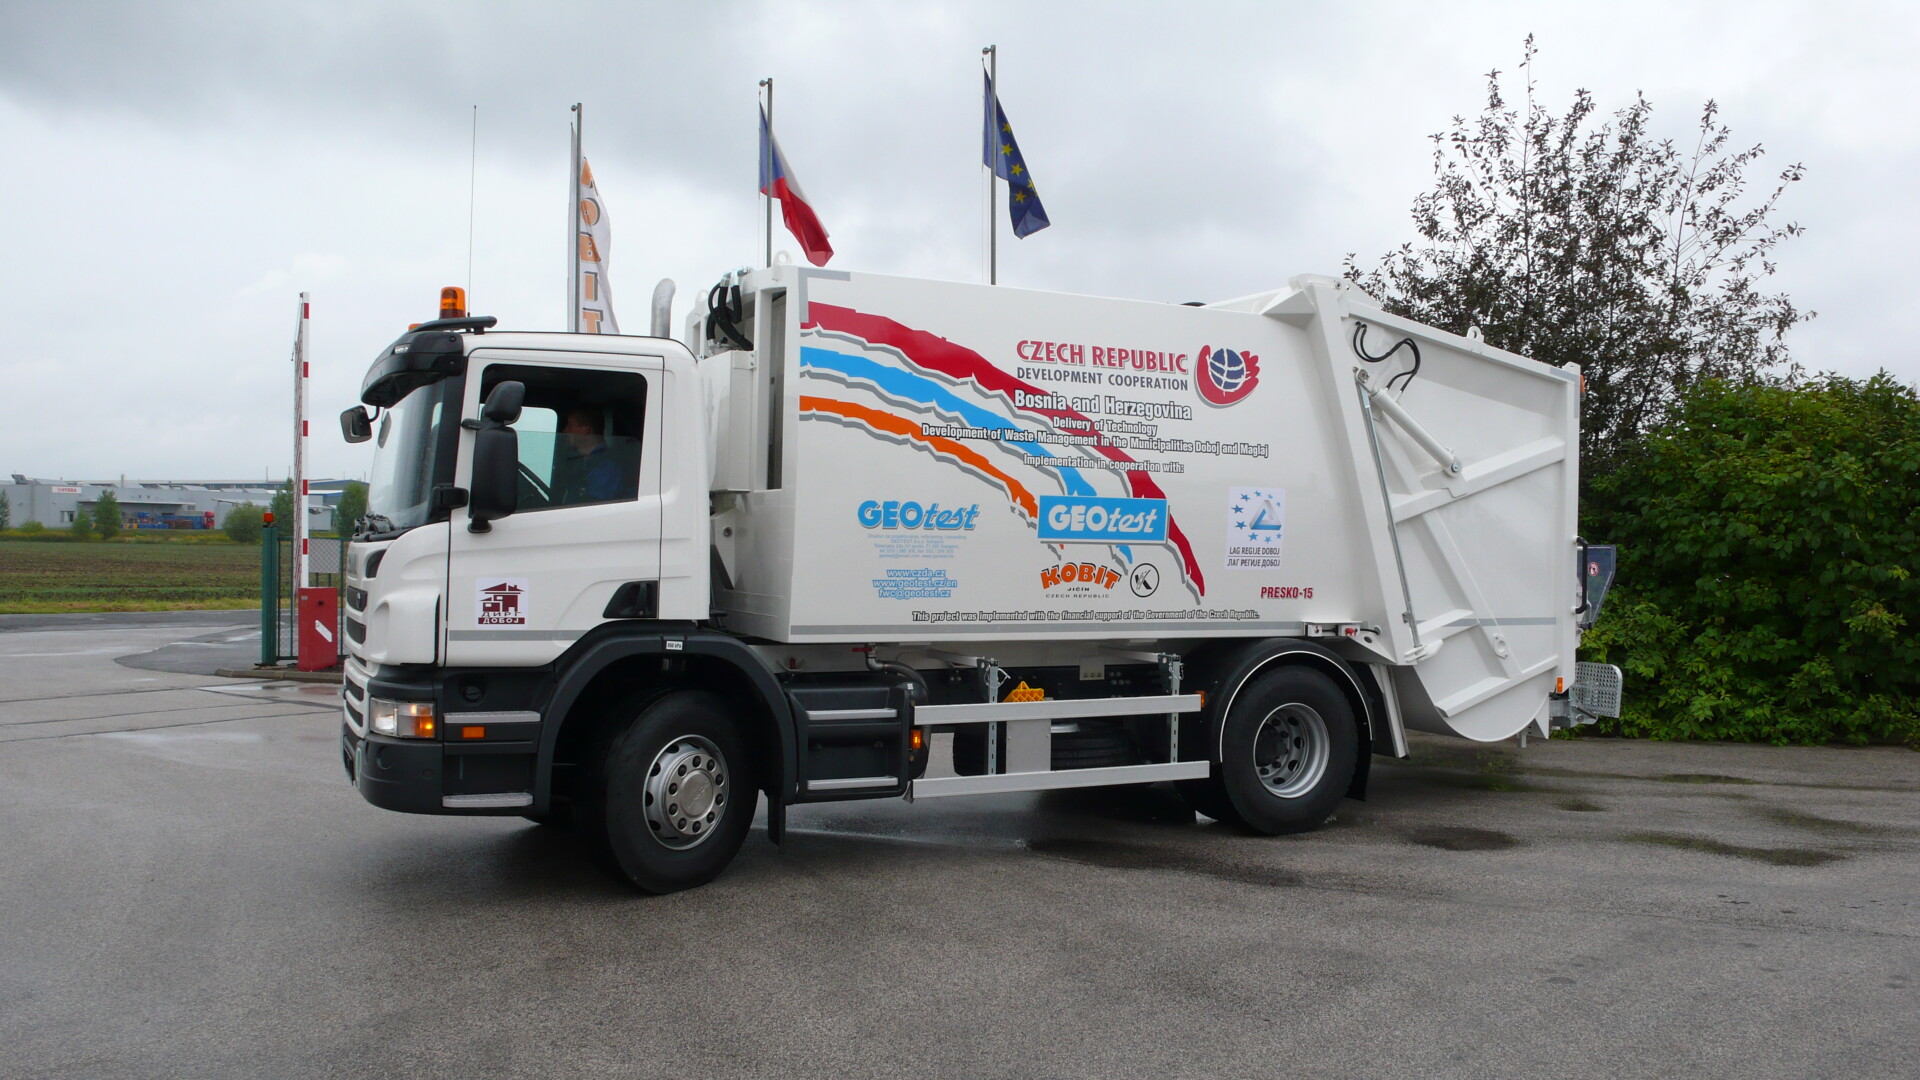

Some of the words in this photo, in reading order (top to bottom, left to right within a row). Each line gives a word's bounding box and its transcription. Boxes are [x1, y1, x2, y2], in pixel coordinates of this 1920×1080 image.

[1016, 340, 1085, 366] CZECH
[1092, 345, 1188, 375] REPUBLIC
[1017, 366, 1103, 385] DEVELOPMENT
[1108, 373, 1188, 391] COOPERATION
[1014, 389, 1067, 411] Bosnia
[1072, 395, 1100, 414] and
[1105, 396, 1192, 420] Herzegovina
[1053, 416, 1091, 432] Delivery
[1094, 419, 1104, 431] of
[1106, 420, 1157, 437] Technology
[922, 423, 988, 441] Development
[990, 428, 1001, 440] of
[1004, 429, 1034, 442] Waste
[1037, 431, 1097, 447] Management
[1100, 435, 1111, 447] in
[1112, 436, 1127, 448] the
[1130, 436, 1193, 453] Municipalities
[1195, 441, 1220, 455] Doboj
[1222, 443, 1238, 454] and
[1239, 444, 1269, 458] Maglaj
[1023, 453, 1094, 469] Implementation
[1097, 458, 1106, 469] in
[1109, 459, 1160, 473] cooperation
[1162, 462, 1185, 473] with:
[857, 500, 980, 530] GEOtest
[1048, 504, 1157, 533] GEOtest
[1229, 547, 1240, 555] LAG
[1241, 547, 1261, 555] REGIJE
[1262, 547, 1280, 556] DOBOJ
[1227, 558, 1239, 567] ЛАГ
[886, 568, 946, 578] www.czda.cz
[1040, 562, 1122, 590] KOBIT
[872, 578, 957, 589] www.geotest.cz/en
[1260, 586, 1314, 599] PRESKO-15
[878, 588, 951, 600] fwc@geotest.cz
[912, 611, 929, 621] This
[961, 611, 977, 621] was
[978, 611, 1028, 622] implemented
[1029, 611, 1046, 621] with
[1047, 611, 1060, 621] the
[1061, 610, 1094, 621] financial
[1095, 610, 1122, 622] support
[1123, 610, 1132, 620] of
[1132, 610, 1145, 620] the
[1146, 610, 1186, 620] Government
[1187, 610, 1195, 620] of
[1196, 610, 1207, 619] the
[1208, 610, 1228, 619] Czech
